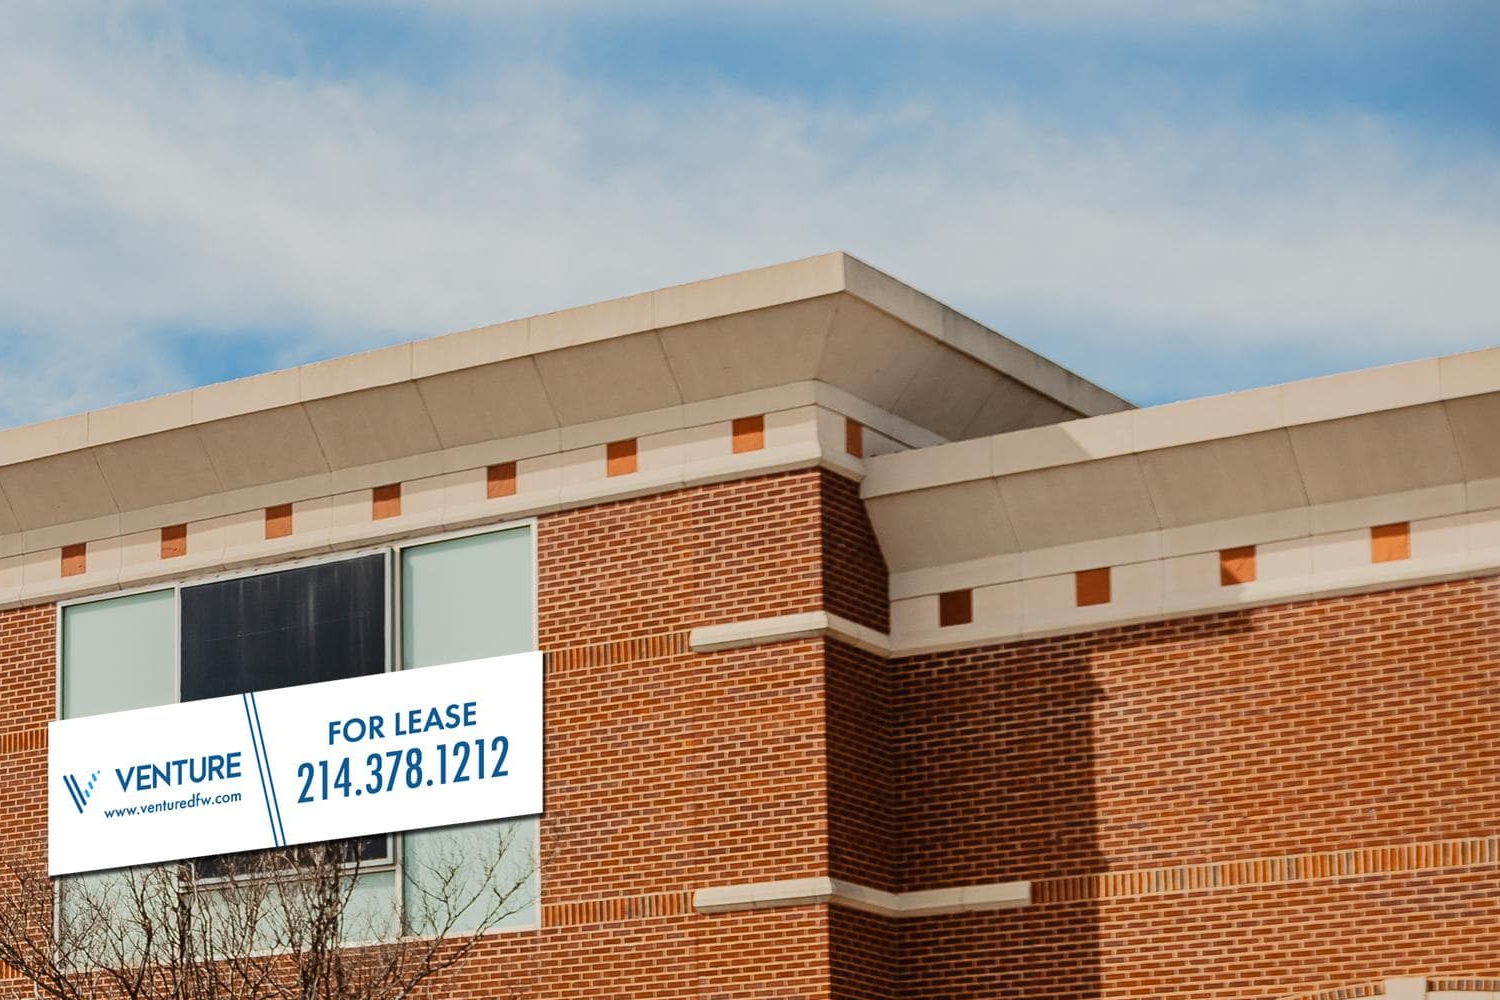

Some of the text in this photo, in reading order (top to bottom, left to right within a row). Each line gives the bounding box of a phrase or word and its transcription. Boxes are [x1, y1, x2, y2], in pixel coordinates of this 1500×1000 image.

[328, 701, 477, 746] FOR LEASE
[115, 751, 242, 793] VENTURE
[297, 735, 509, 804] 214.378.1212
[104, 792, 242, 819] www.venturedfw.com
